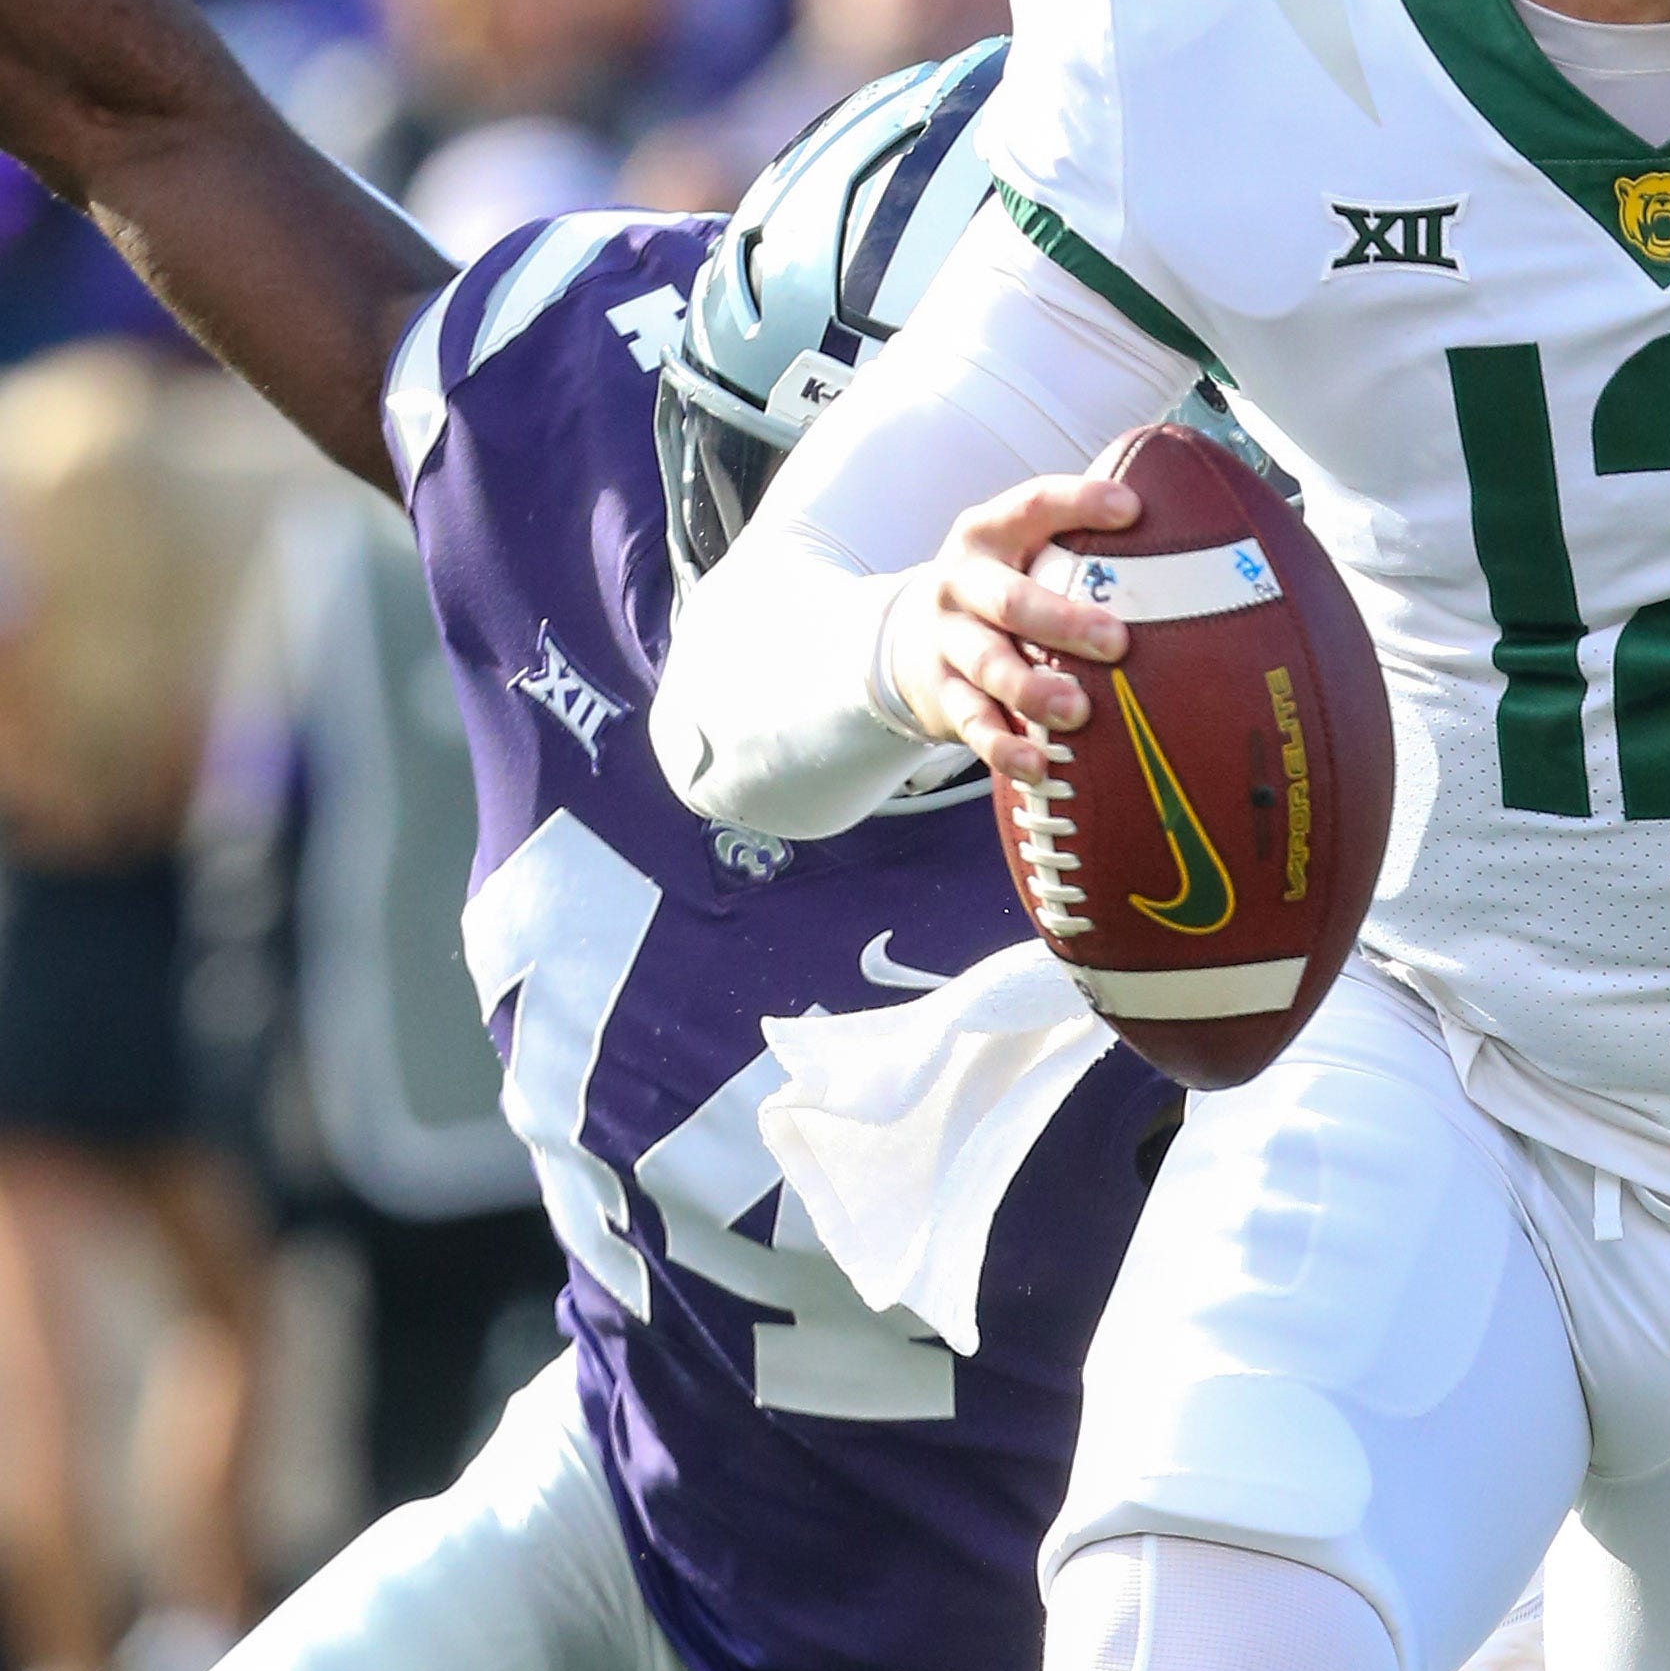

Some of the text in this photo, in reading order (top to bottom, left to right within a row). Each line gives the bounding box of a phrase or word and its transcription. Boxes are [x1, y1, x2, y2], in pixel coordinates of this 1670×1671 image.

[1331, 202, 1459, 271] XII
[518, 635, 623, 762] XII
[461, 807, 957, 1421] 14
